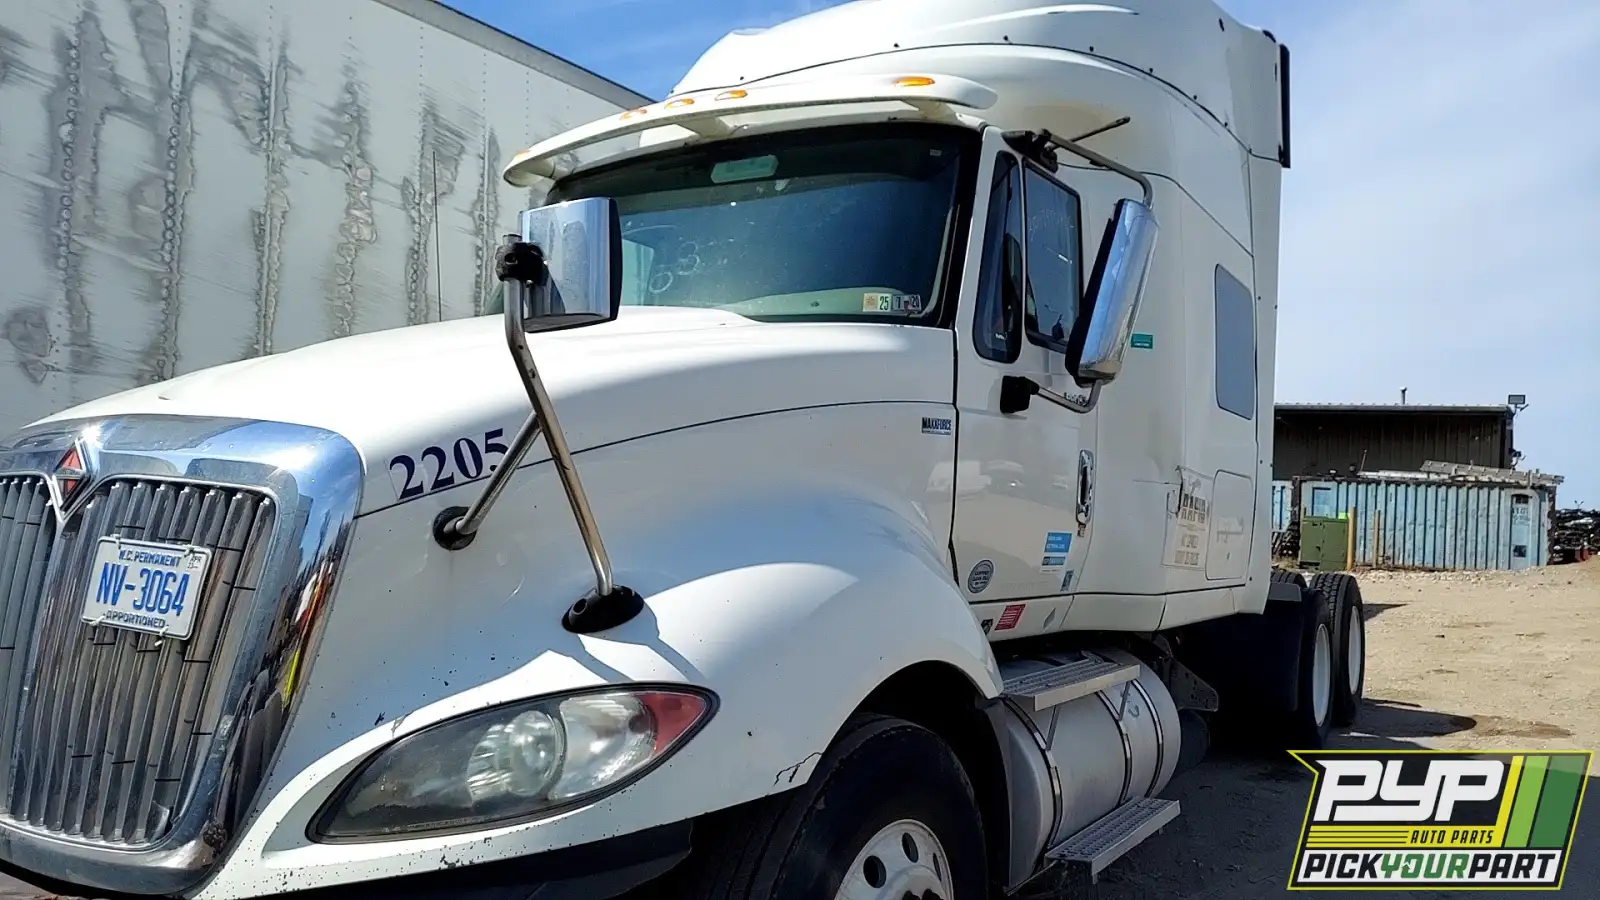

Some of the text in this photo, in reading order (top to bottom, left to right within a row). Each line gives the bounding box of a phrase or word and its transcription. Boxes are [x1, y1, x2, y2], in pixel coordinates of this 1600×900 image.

[880, 296, 889, 310] 25
[389, 428, 509, 500] 2205
[134, 550, 182, 567] PERMANENT
[96, 562, 190, 617] NV-3064
